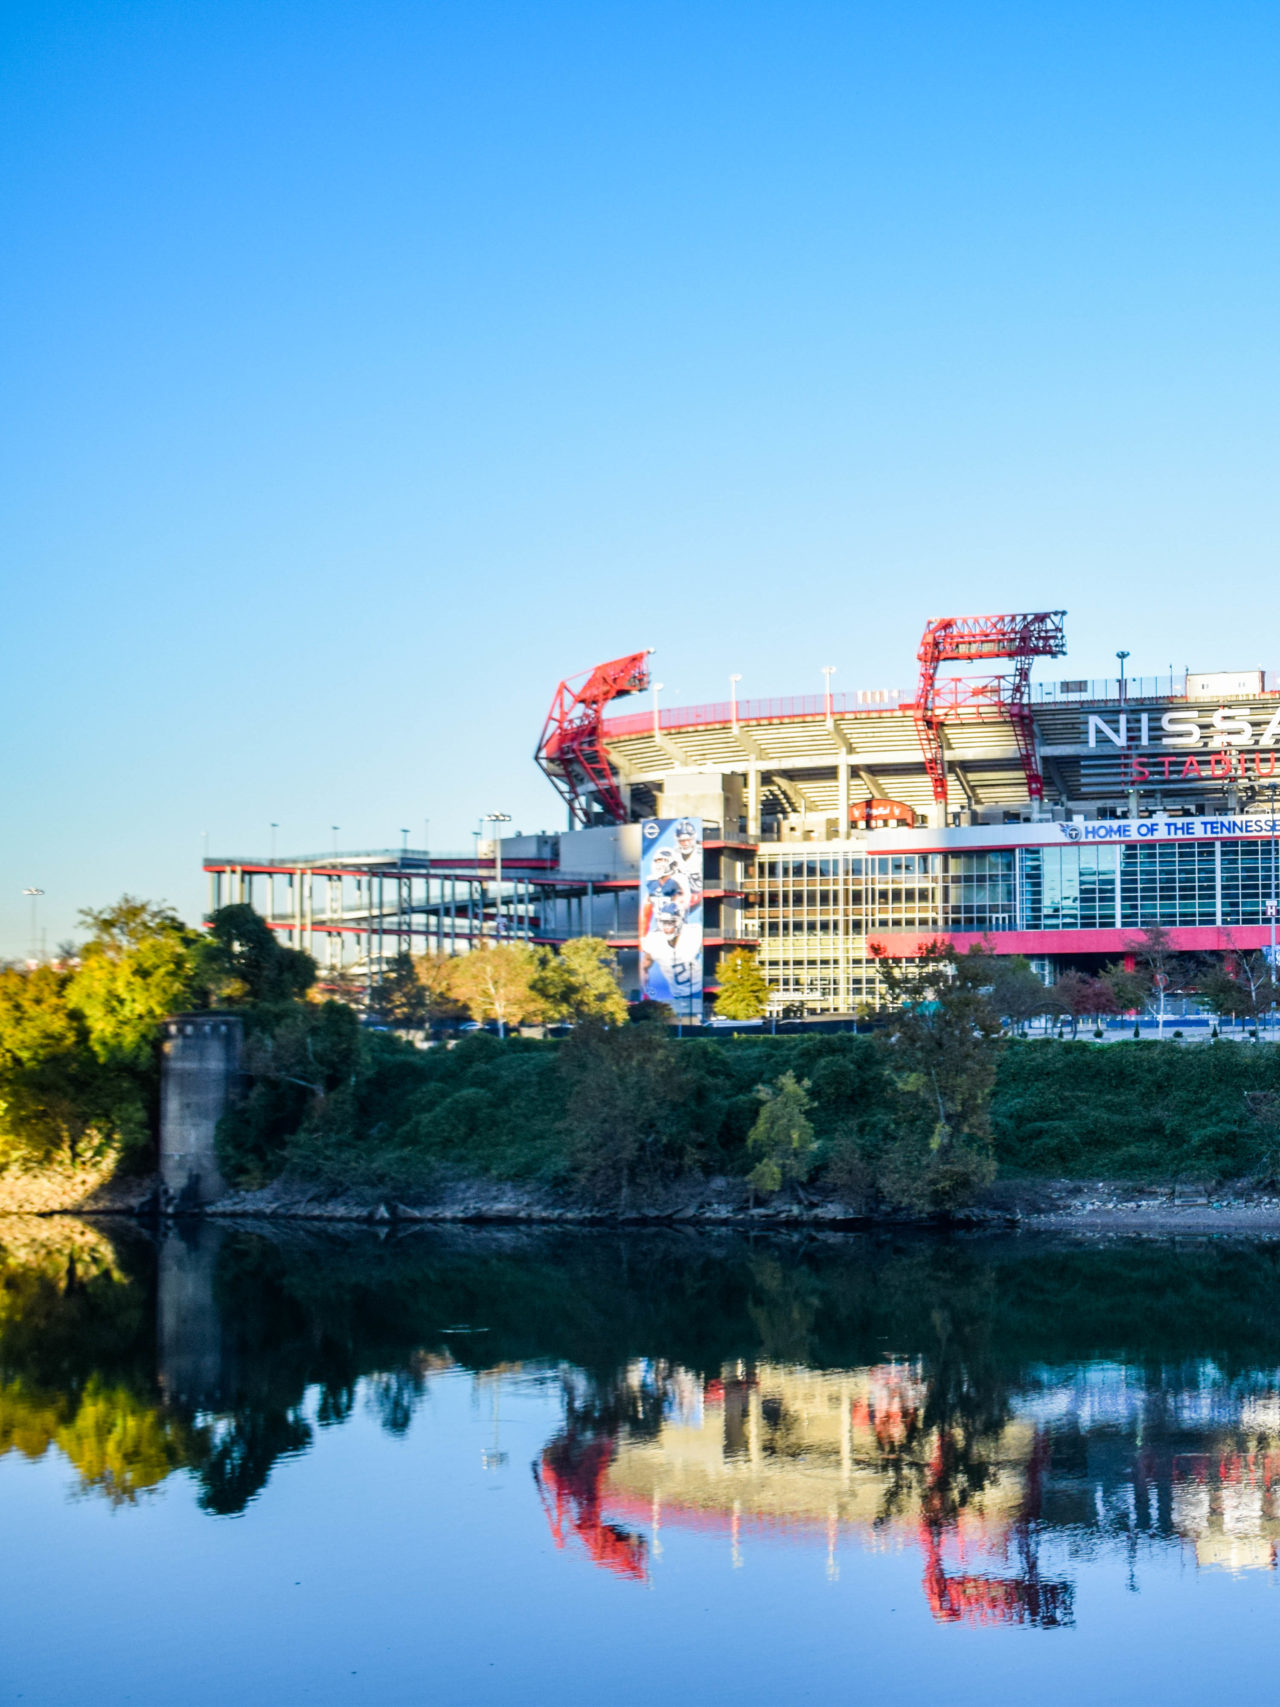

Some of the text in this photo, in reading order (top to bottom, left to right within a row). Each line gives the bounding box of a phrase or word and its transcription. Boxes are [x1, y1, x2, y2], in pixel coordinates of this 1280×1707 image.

[1085, 824, 1131, 840] HOME
[1137, 823, 1159, 837] OF
[1164, 822, 1195, 836] THE
[1267, 905, 1277, 916] H
